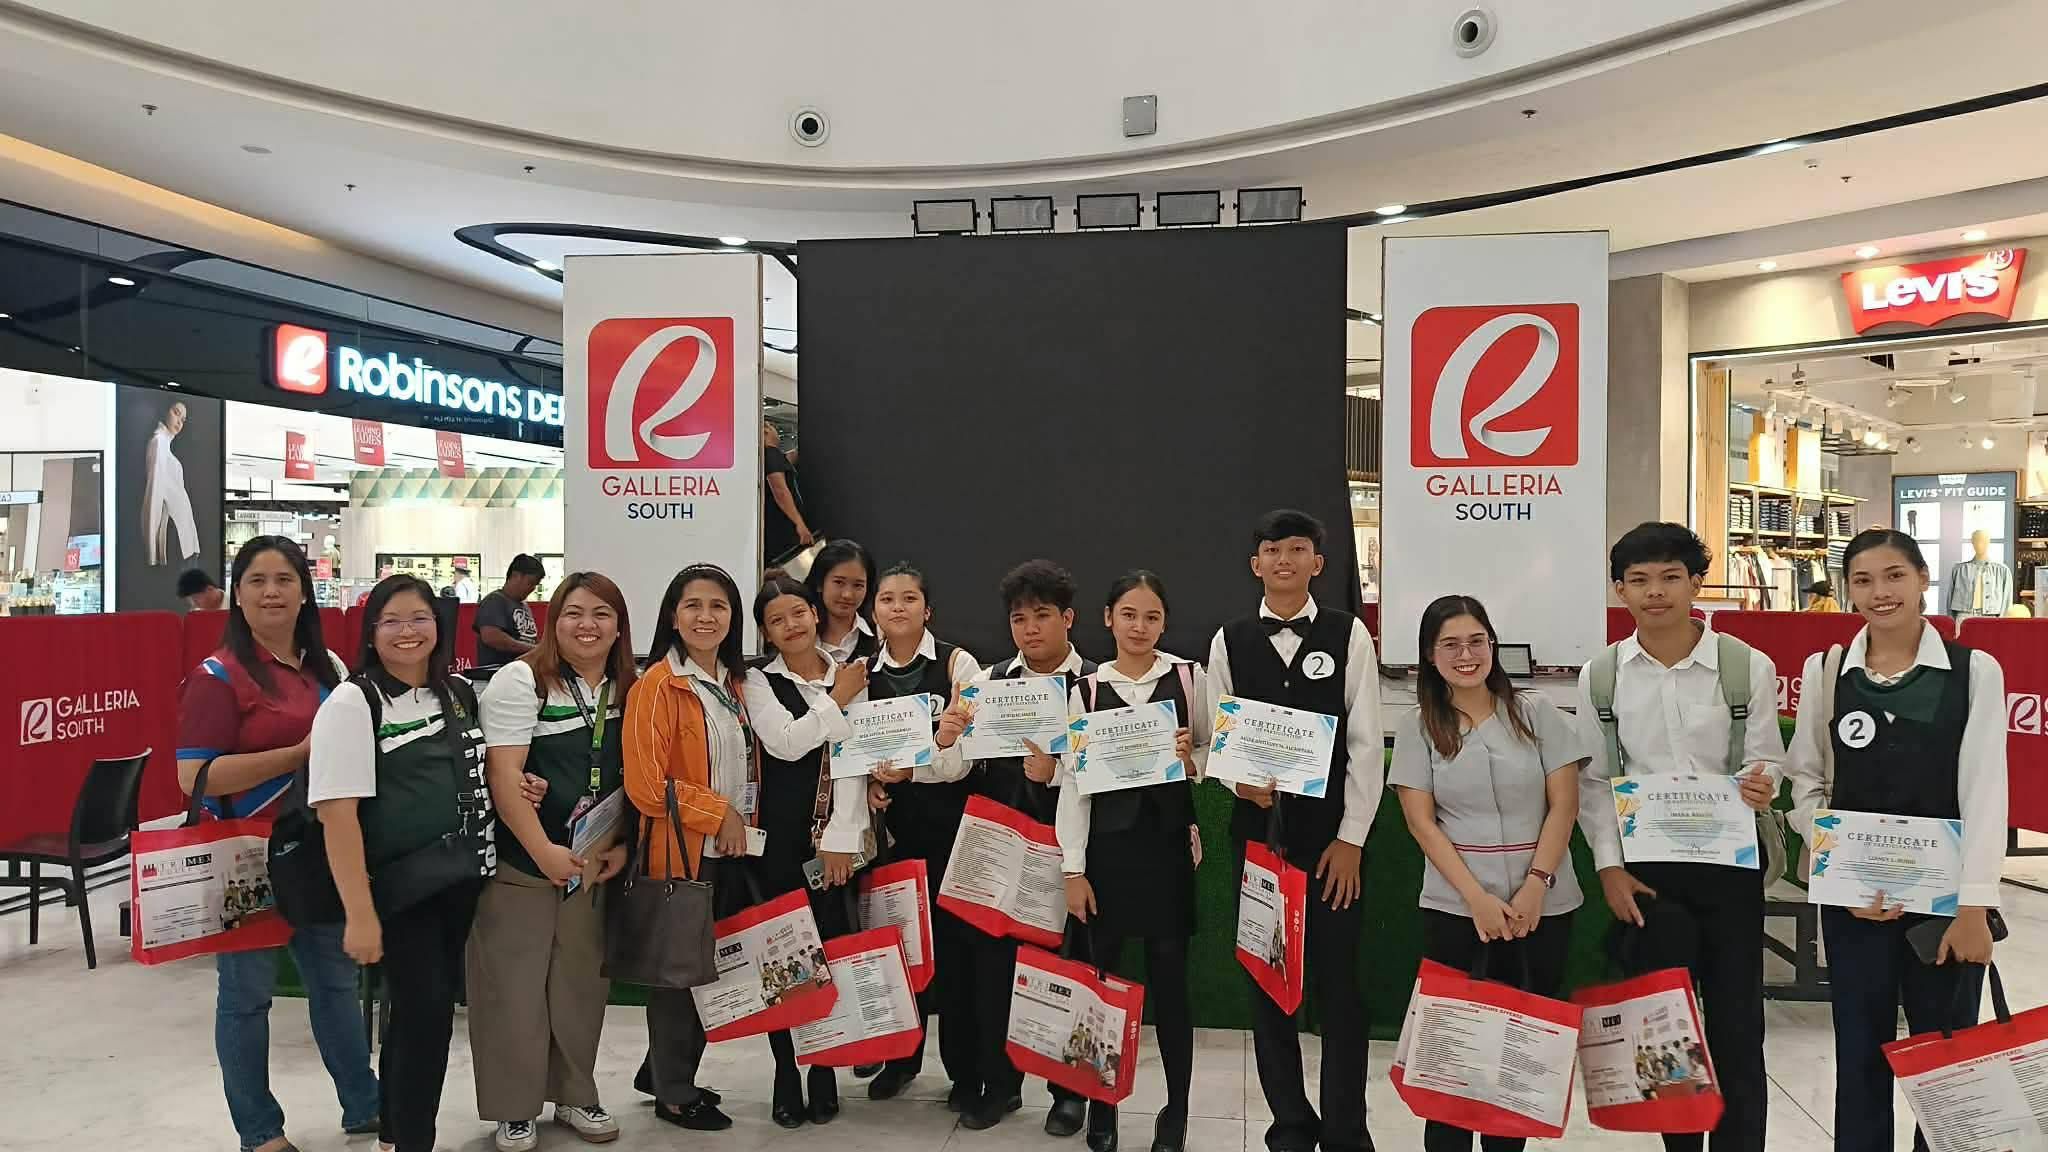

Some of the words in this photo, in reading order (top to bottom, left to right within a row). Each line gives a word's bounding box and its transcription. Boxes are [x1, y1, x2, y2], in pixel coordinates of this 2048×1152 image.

[338, 345, 523, 419] Robinsons
[602, 475, 721, 496] GALLERIA
[1426, 473, 1563, 497] GALLERIA
[1944, 487, 1964, 497] FIT
[1966, 486, 2007, 497] GUIDE
[627, 502, 694, 520] SOUTH
[1455, 502, 1532, 521] SOUTH
[1311, 655, 1326, 676] 2
[56, 688, 141, 718] GALLERIA
[984, 693, 1049, 704] CERTIFICATE
[853, 711, 914, 725] CERTIFICATE
[1095, 719, 1160, 736] CERTIFICATE
[56, 717, 105, 740] SOUTH
[1243, 718, 1315, 738] CERTIFICATE
[1848, 718, 1866, 741] 2
[1647, 791, 1730, 802] CERTIFICATE
[1847, 832, 1939, 849] CERTIFICATE
